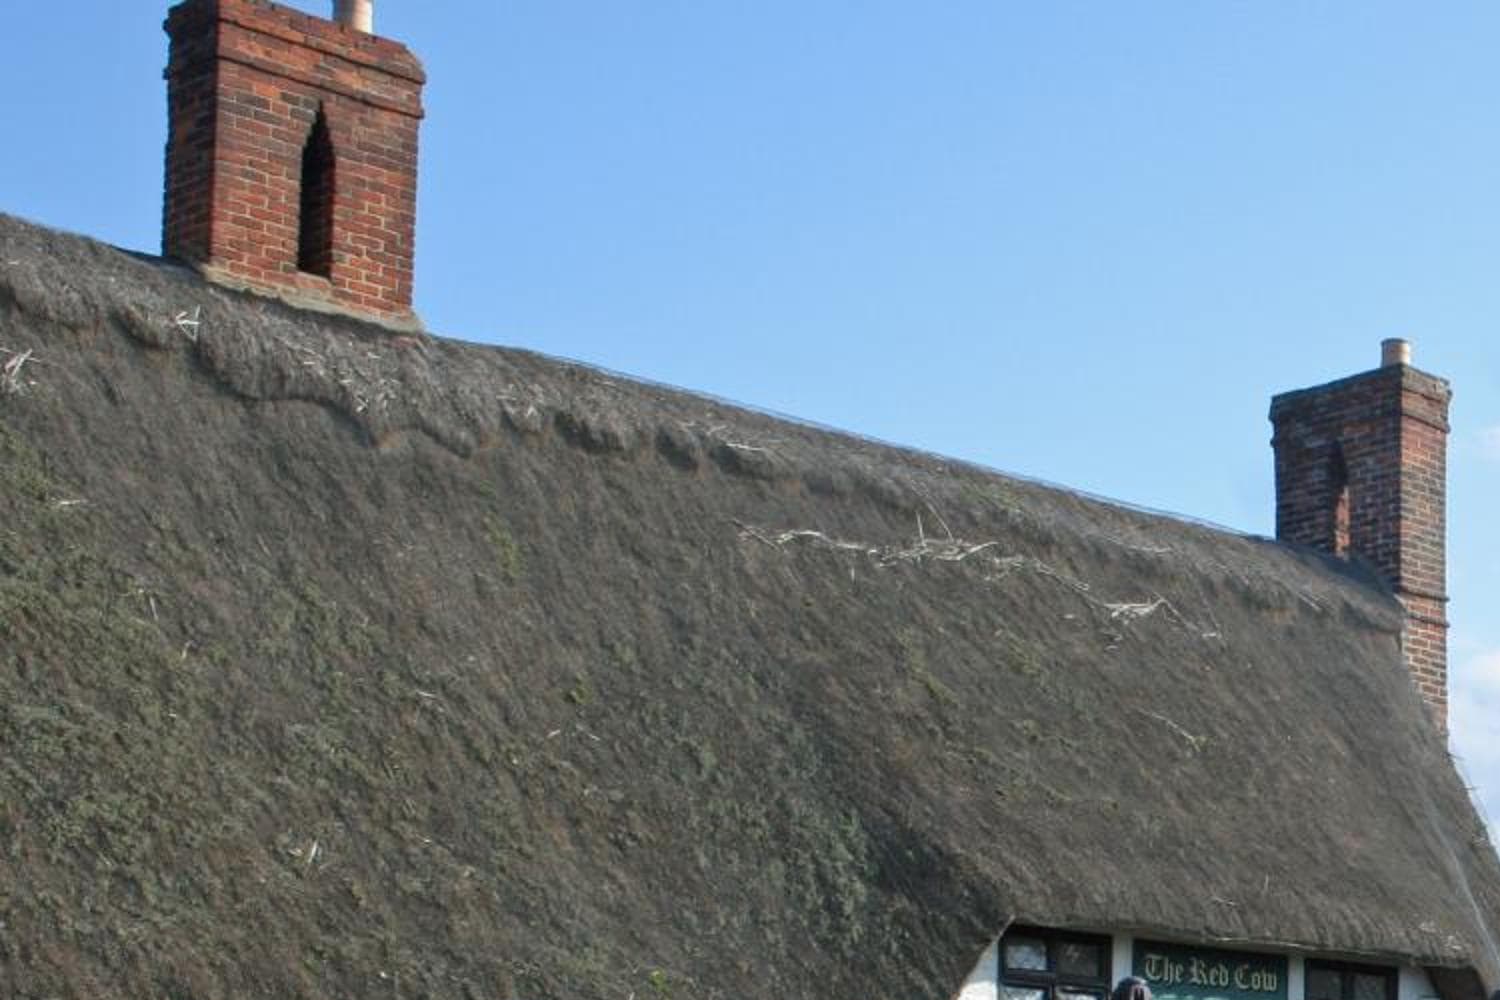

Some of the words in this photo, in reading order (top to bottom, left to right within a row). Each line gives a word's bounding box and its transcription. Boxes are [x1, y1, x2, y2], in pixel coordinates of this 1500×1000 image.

[1146, 954, 1183, 985] The
[1189, 957, 1229, 987] Red
[1235, 965, 1277, 992] Cow
